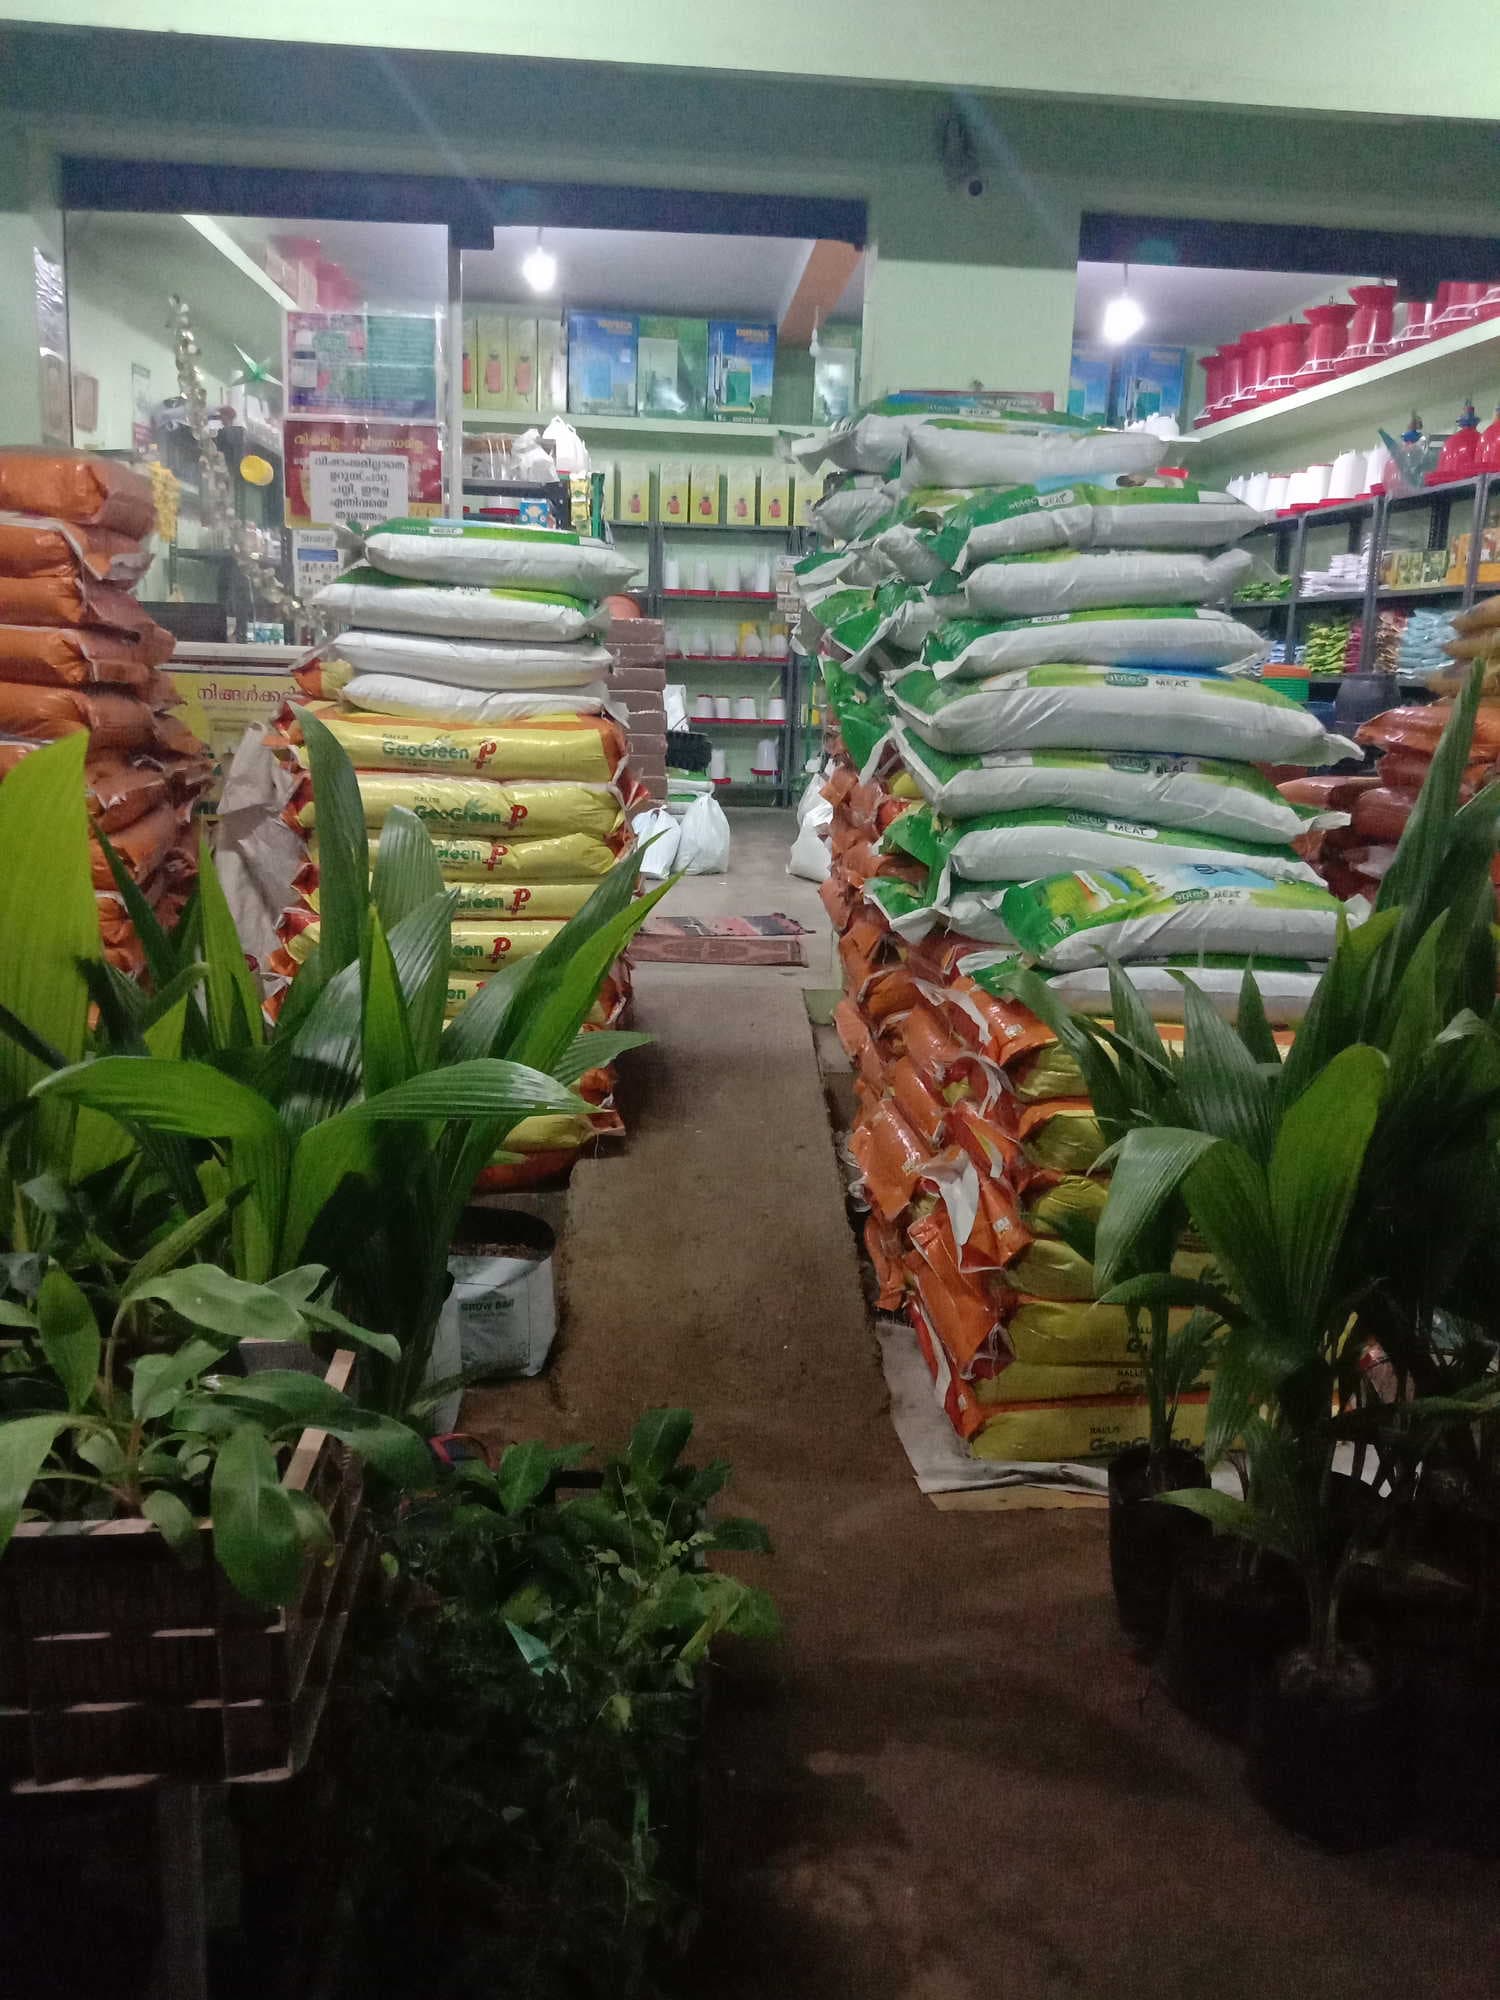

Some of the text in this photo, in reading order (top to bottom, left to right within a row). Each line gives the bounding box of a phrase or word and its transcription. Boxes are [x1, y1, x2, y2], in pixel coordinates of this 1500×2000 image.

[1155, 679, 1190, 688] MEAT
[382, 741, 469, 760] GeoGreen
[1113, 824, 1147, 836] MEAT
